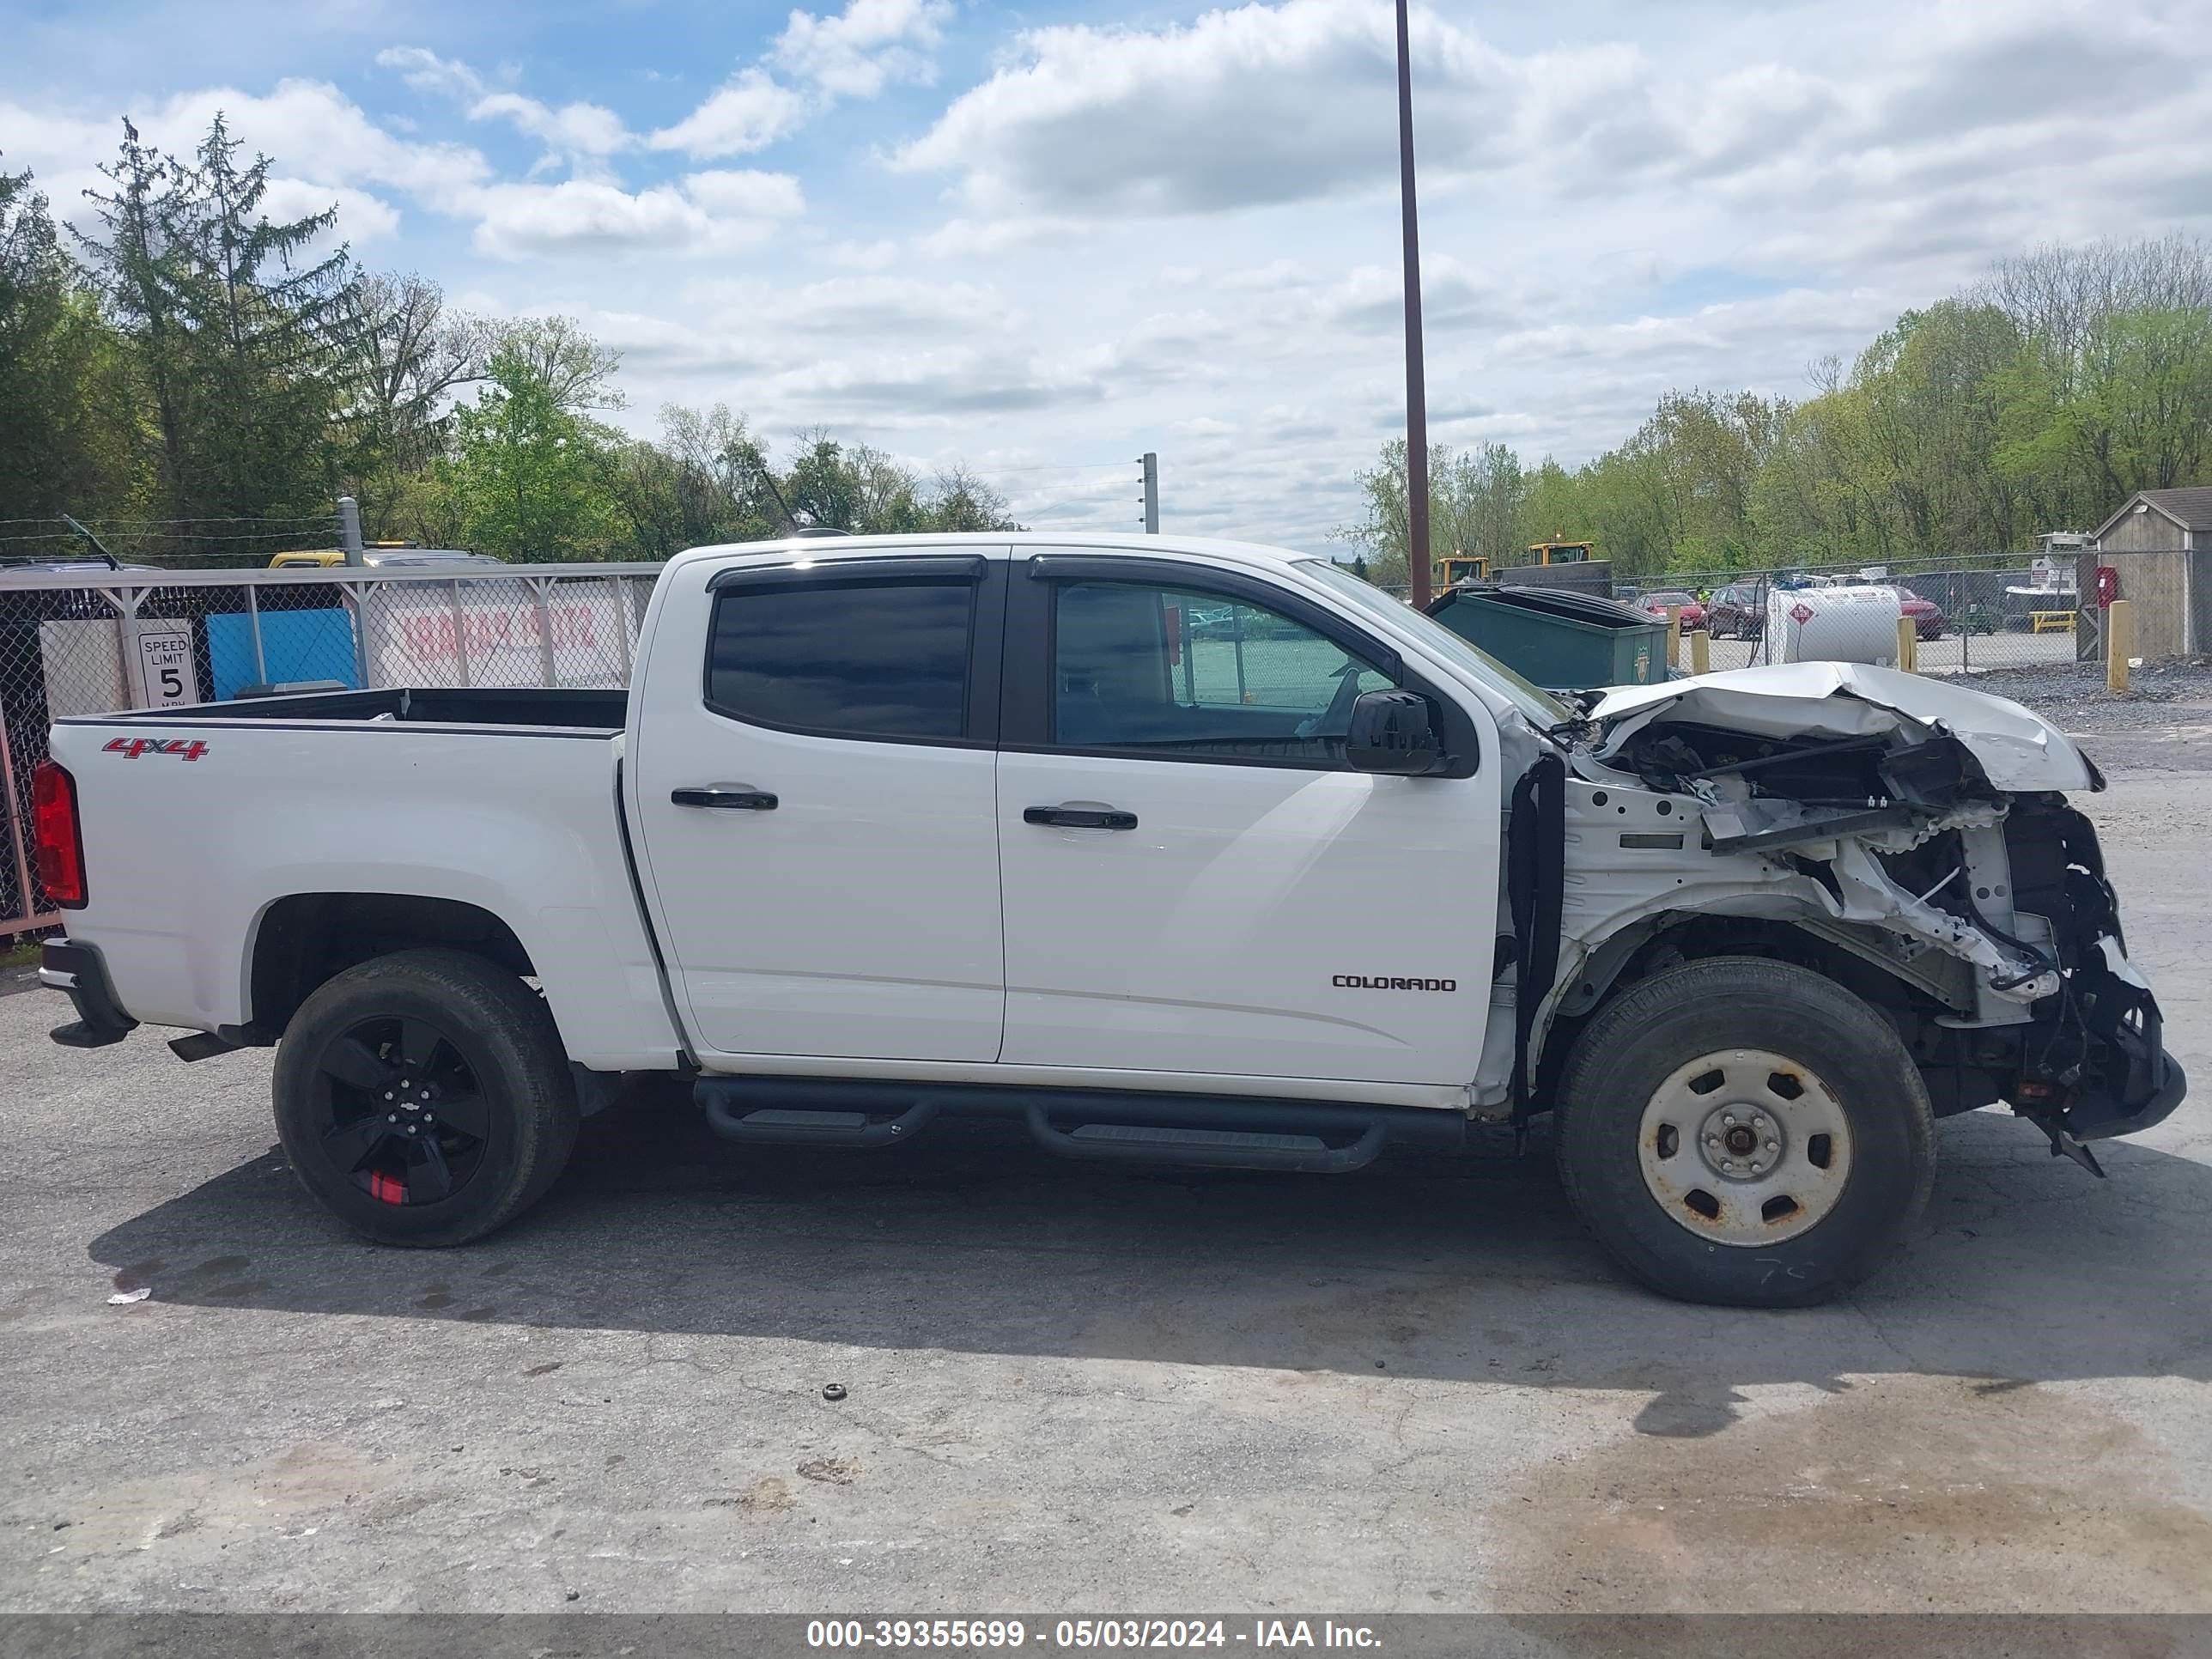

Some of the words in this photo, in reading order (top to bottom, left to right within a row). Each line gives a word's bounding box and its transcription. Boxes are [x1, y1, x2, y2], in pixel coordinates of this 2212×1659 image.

[144, 640, 186, 653] SPEED
[151, 653, 184, 665] LIMIT
[161, 668, 183, 698] 5
[1333, 975, 1456, 992] COLORADO
